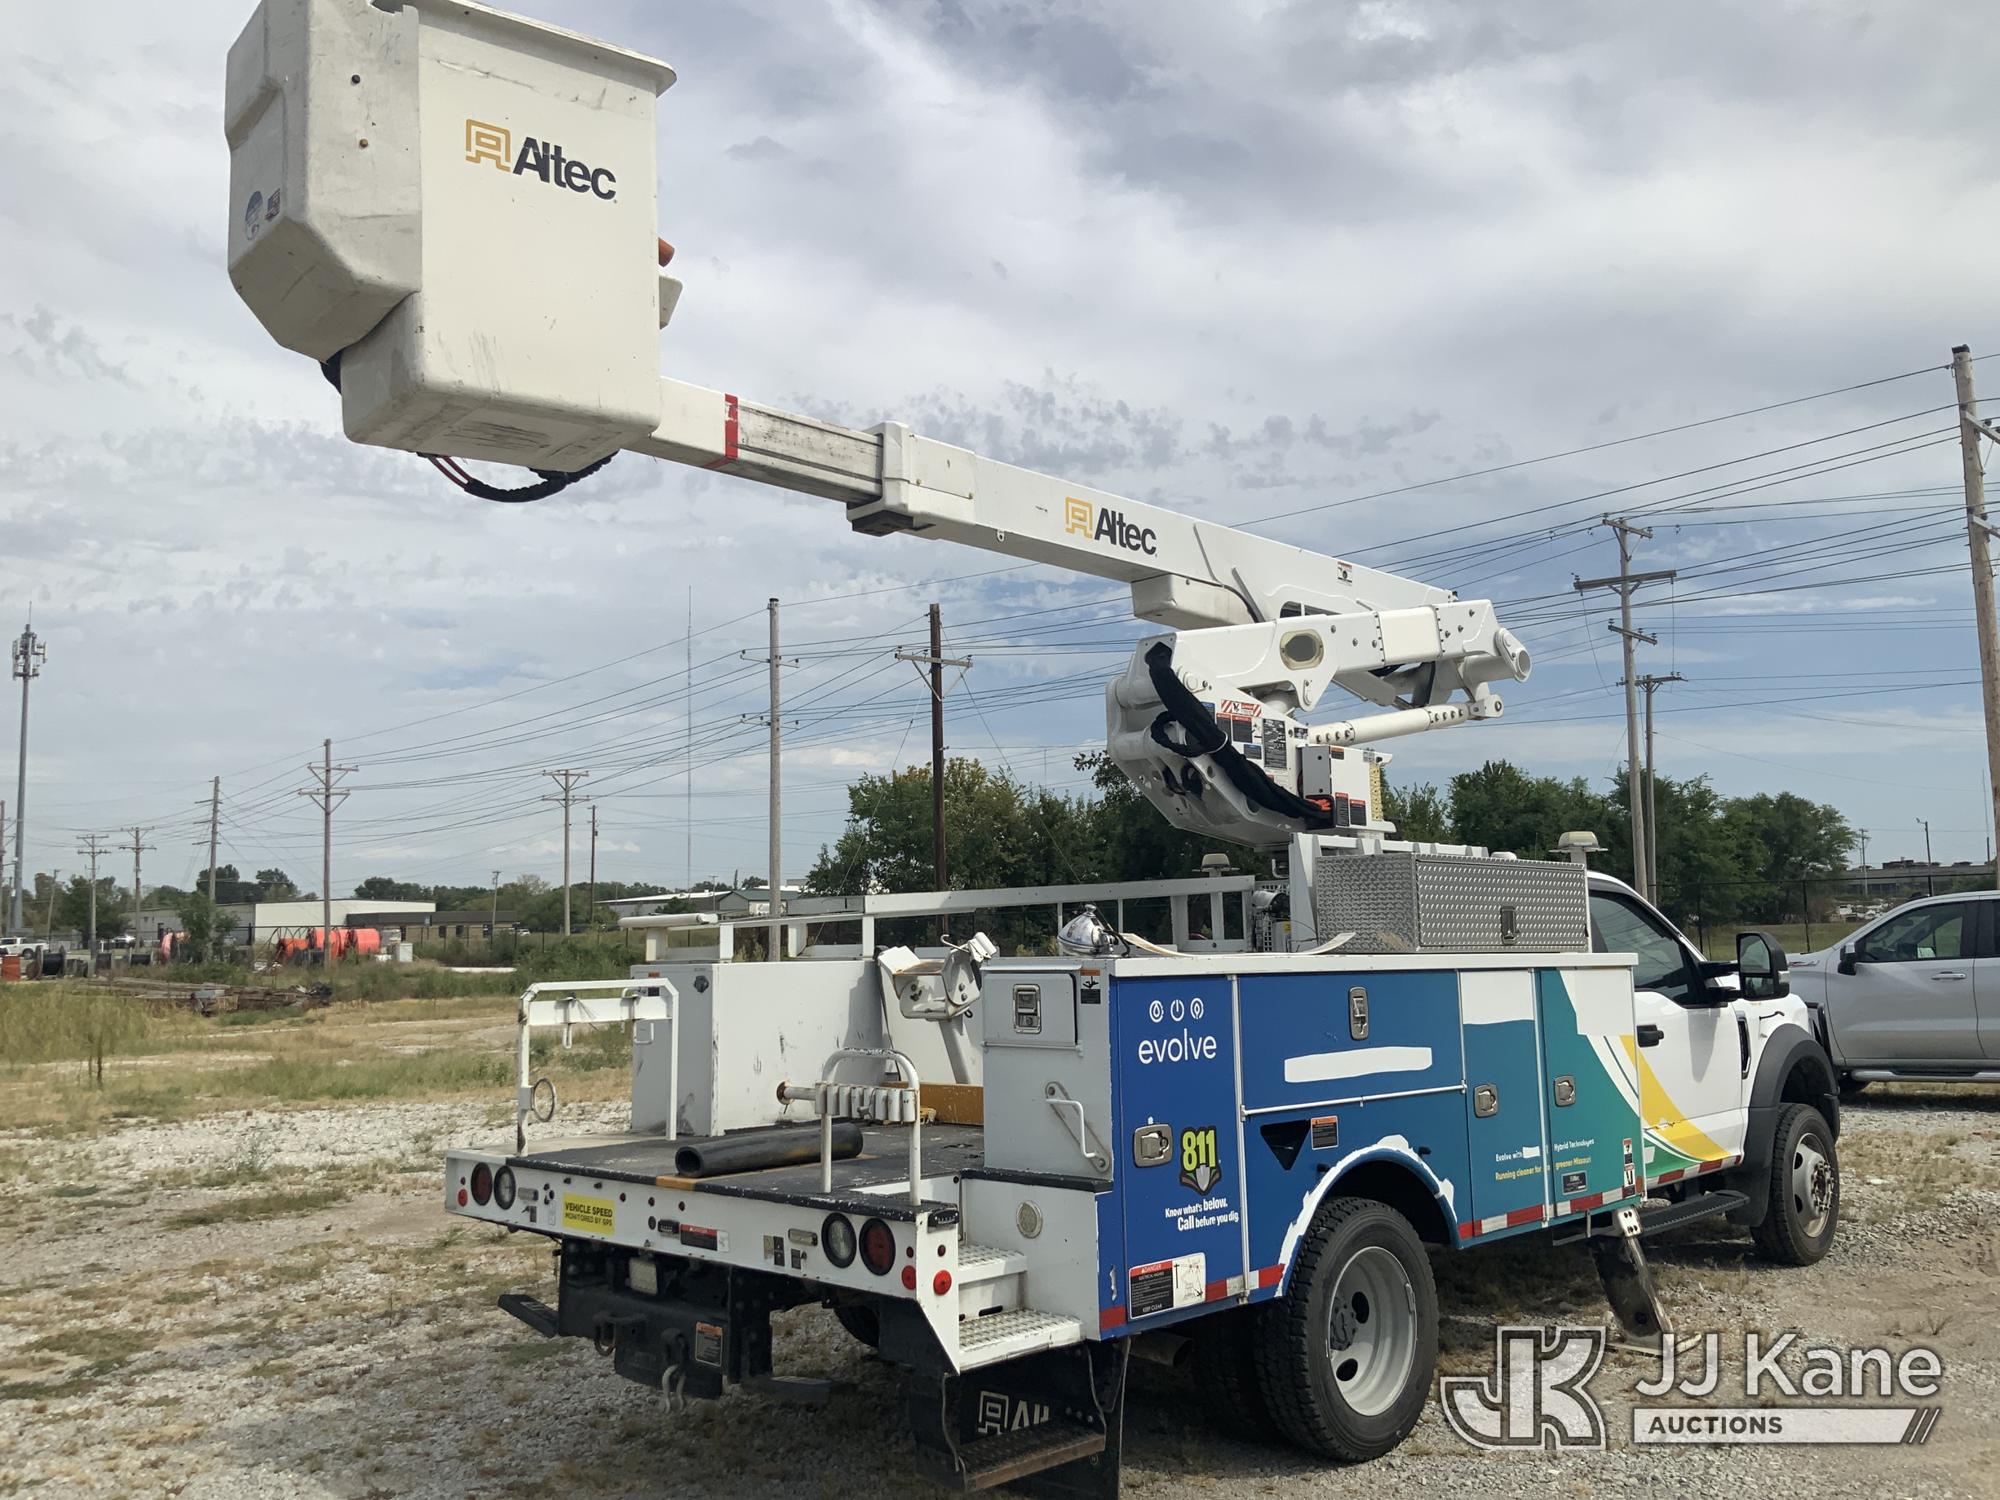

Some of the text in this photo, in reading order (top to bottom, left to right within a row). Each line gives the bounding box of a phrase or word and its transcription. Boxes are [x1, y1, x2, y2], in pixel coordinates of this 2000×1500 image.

[513, 136, 617, 200] Altec
[1094, 507, 1157, 556] Altec
[1138, 1028, 1217, 1064] evolve
[1182, 1129, 1216, 1171] 811
[1495, 1153, 1511, 1161] Evolve
[1495, 1171, 1516, 1180] Running
[1516, 1168, 1534, 1177] cleaner
[565, 1201, 613, 1218] VEHICLE SPEED
[1165, 1207, 1183, 1218] Know
[1183, 1203, 1203, 1214] what's
[1177, 1215, 1195, 1231] Call
[1195, 1215, 1216, 1228] before
[1217, 1214, 1228, 1226] you
